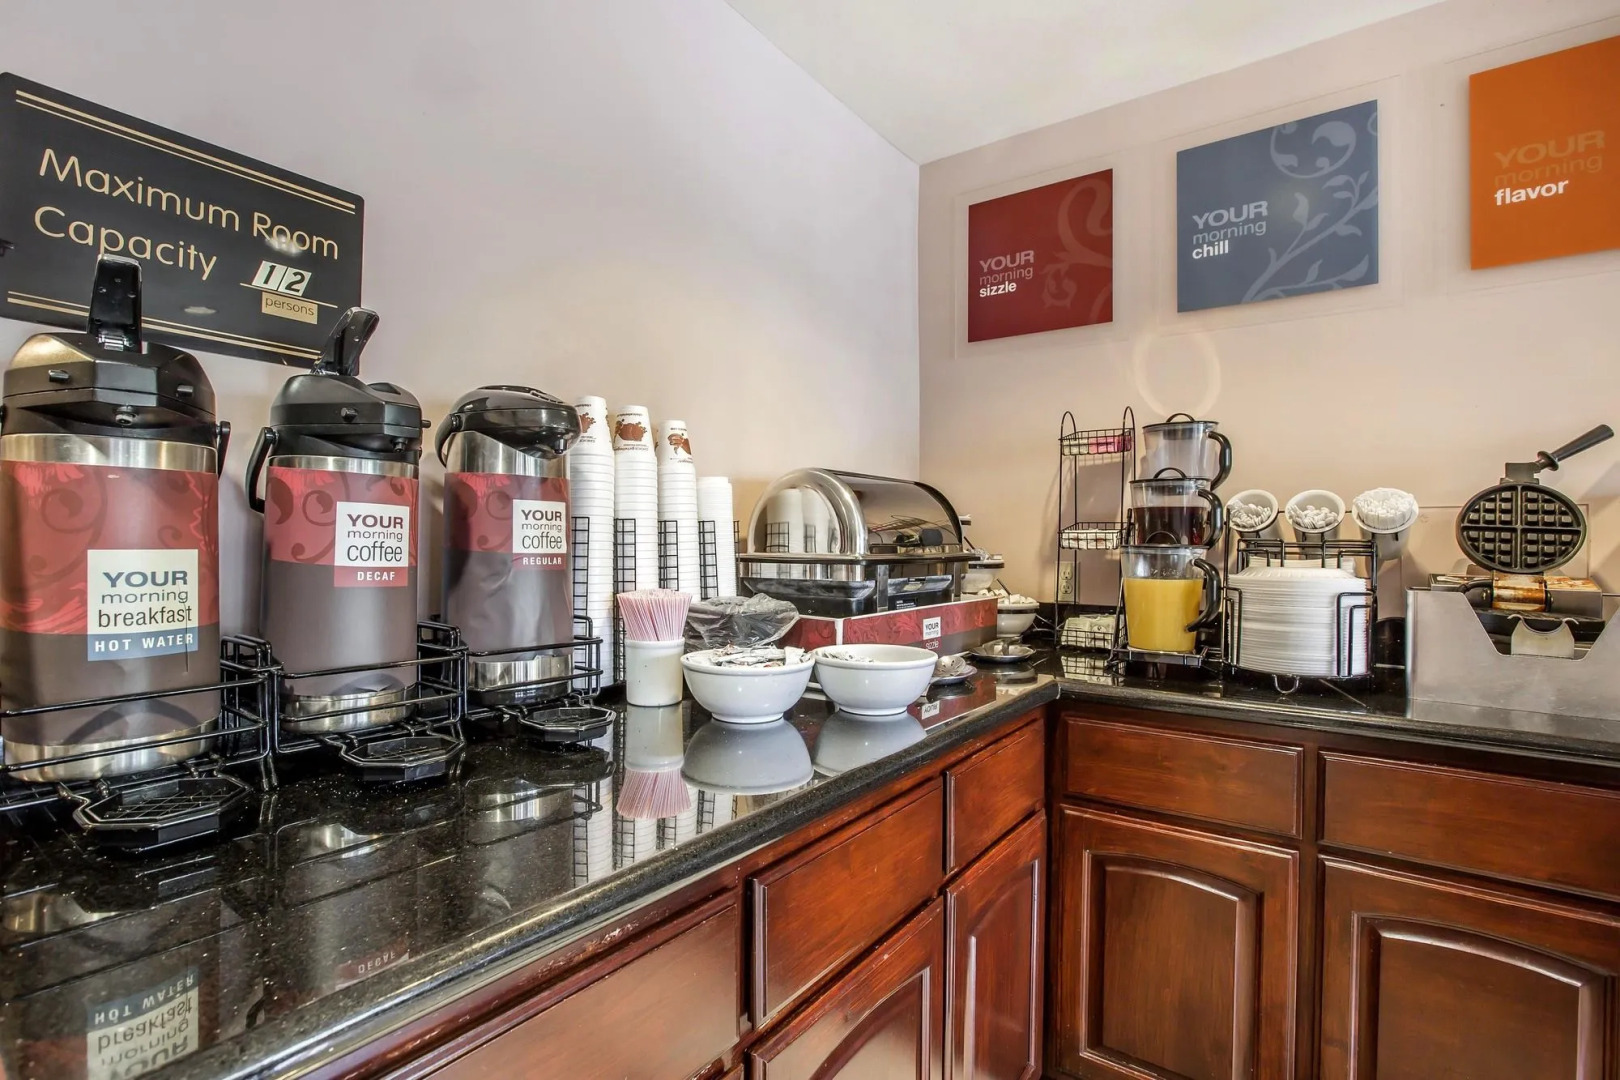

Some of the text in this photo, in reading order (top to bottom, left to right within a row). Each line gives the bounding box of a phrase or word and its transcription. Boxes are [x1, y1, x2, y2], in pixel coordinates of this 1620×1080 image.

[1494, 130, 1605, 169] YOUR
[1494, 154, 1603, 187] morning
[1494, 180, 1569, 206] flavor
[39, 148, 338, 260] Maximum Room
[1192, 200, 1268, 229] YOUR
[1193, 221, 1267, 245] morning
[34, 206, 217, 281] Capacity
[1192, 240, 1229, 259] chill
[979, 250, 1034, 273] YOUR
[262, 264, 306, 293] 12
[980, 267, 1033, 285] morning
[979, 281, 1017, 298] sizzle
[265, 297, 315, 316] persons
[347, 513, 404, 529] YOUR
[521, 509, 562, 521] YOUR
[347, 530, 403, 543] morning
[521, 522, 562, 533] morning
[522, 531, 562, 549] coffee
[347, 541, 403, 562] coffee
[522, 556, 562, 565] REGULAR
[102, 570, 188, 588] YOUR
[357, 571, 396, 581] DECAF
[101, 589, 189, 605] morning
[98, 605, 192, 628] breakfast
[925, 622, 939, 630] YOUR
[94, 633, 194, 652] HOT WATER
